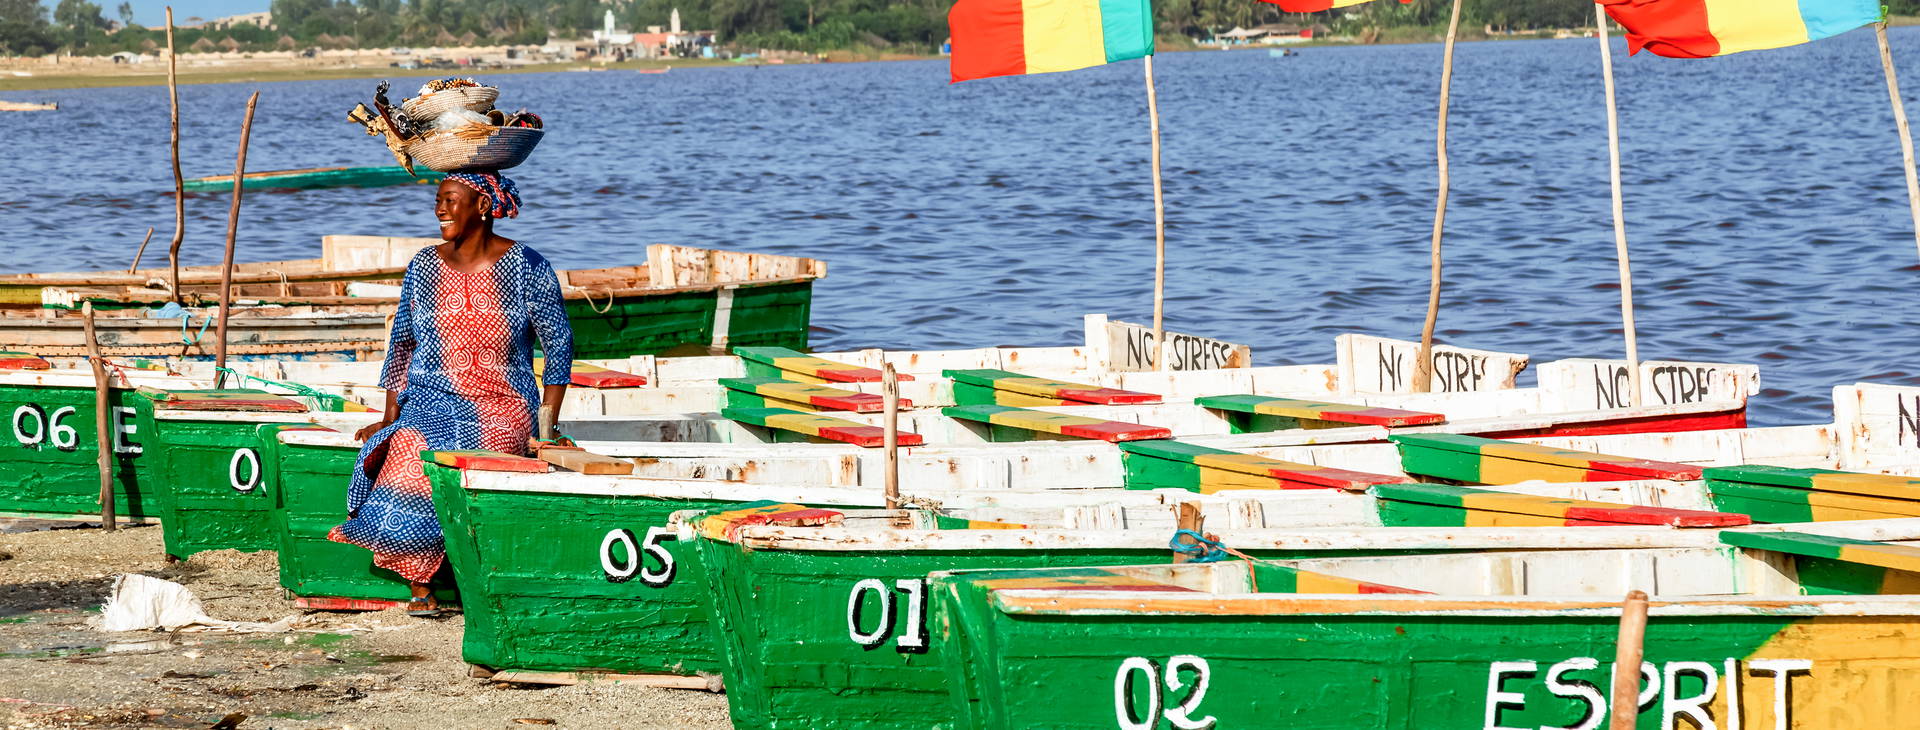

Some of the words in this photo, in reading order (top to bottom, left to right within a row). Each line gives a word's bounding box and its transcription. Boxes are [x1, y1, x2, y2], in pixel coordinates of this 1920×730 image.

[12, 402, 80, 452] 06
[229, 448, 268, 493] 0
[599, 526, 678, 588] 05
[847, 578, 930, 654] 01
[1114, 654, 1218, 730] 02
